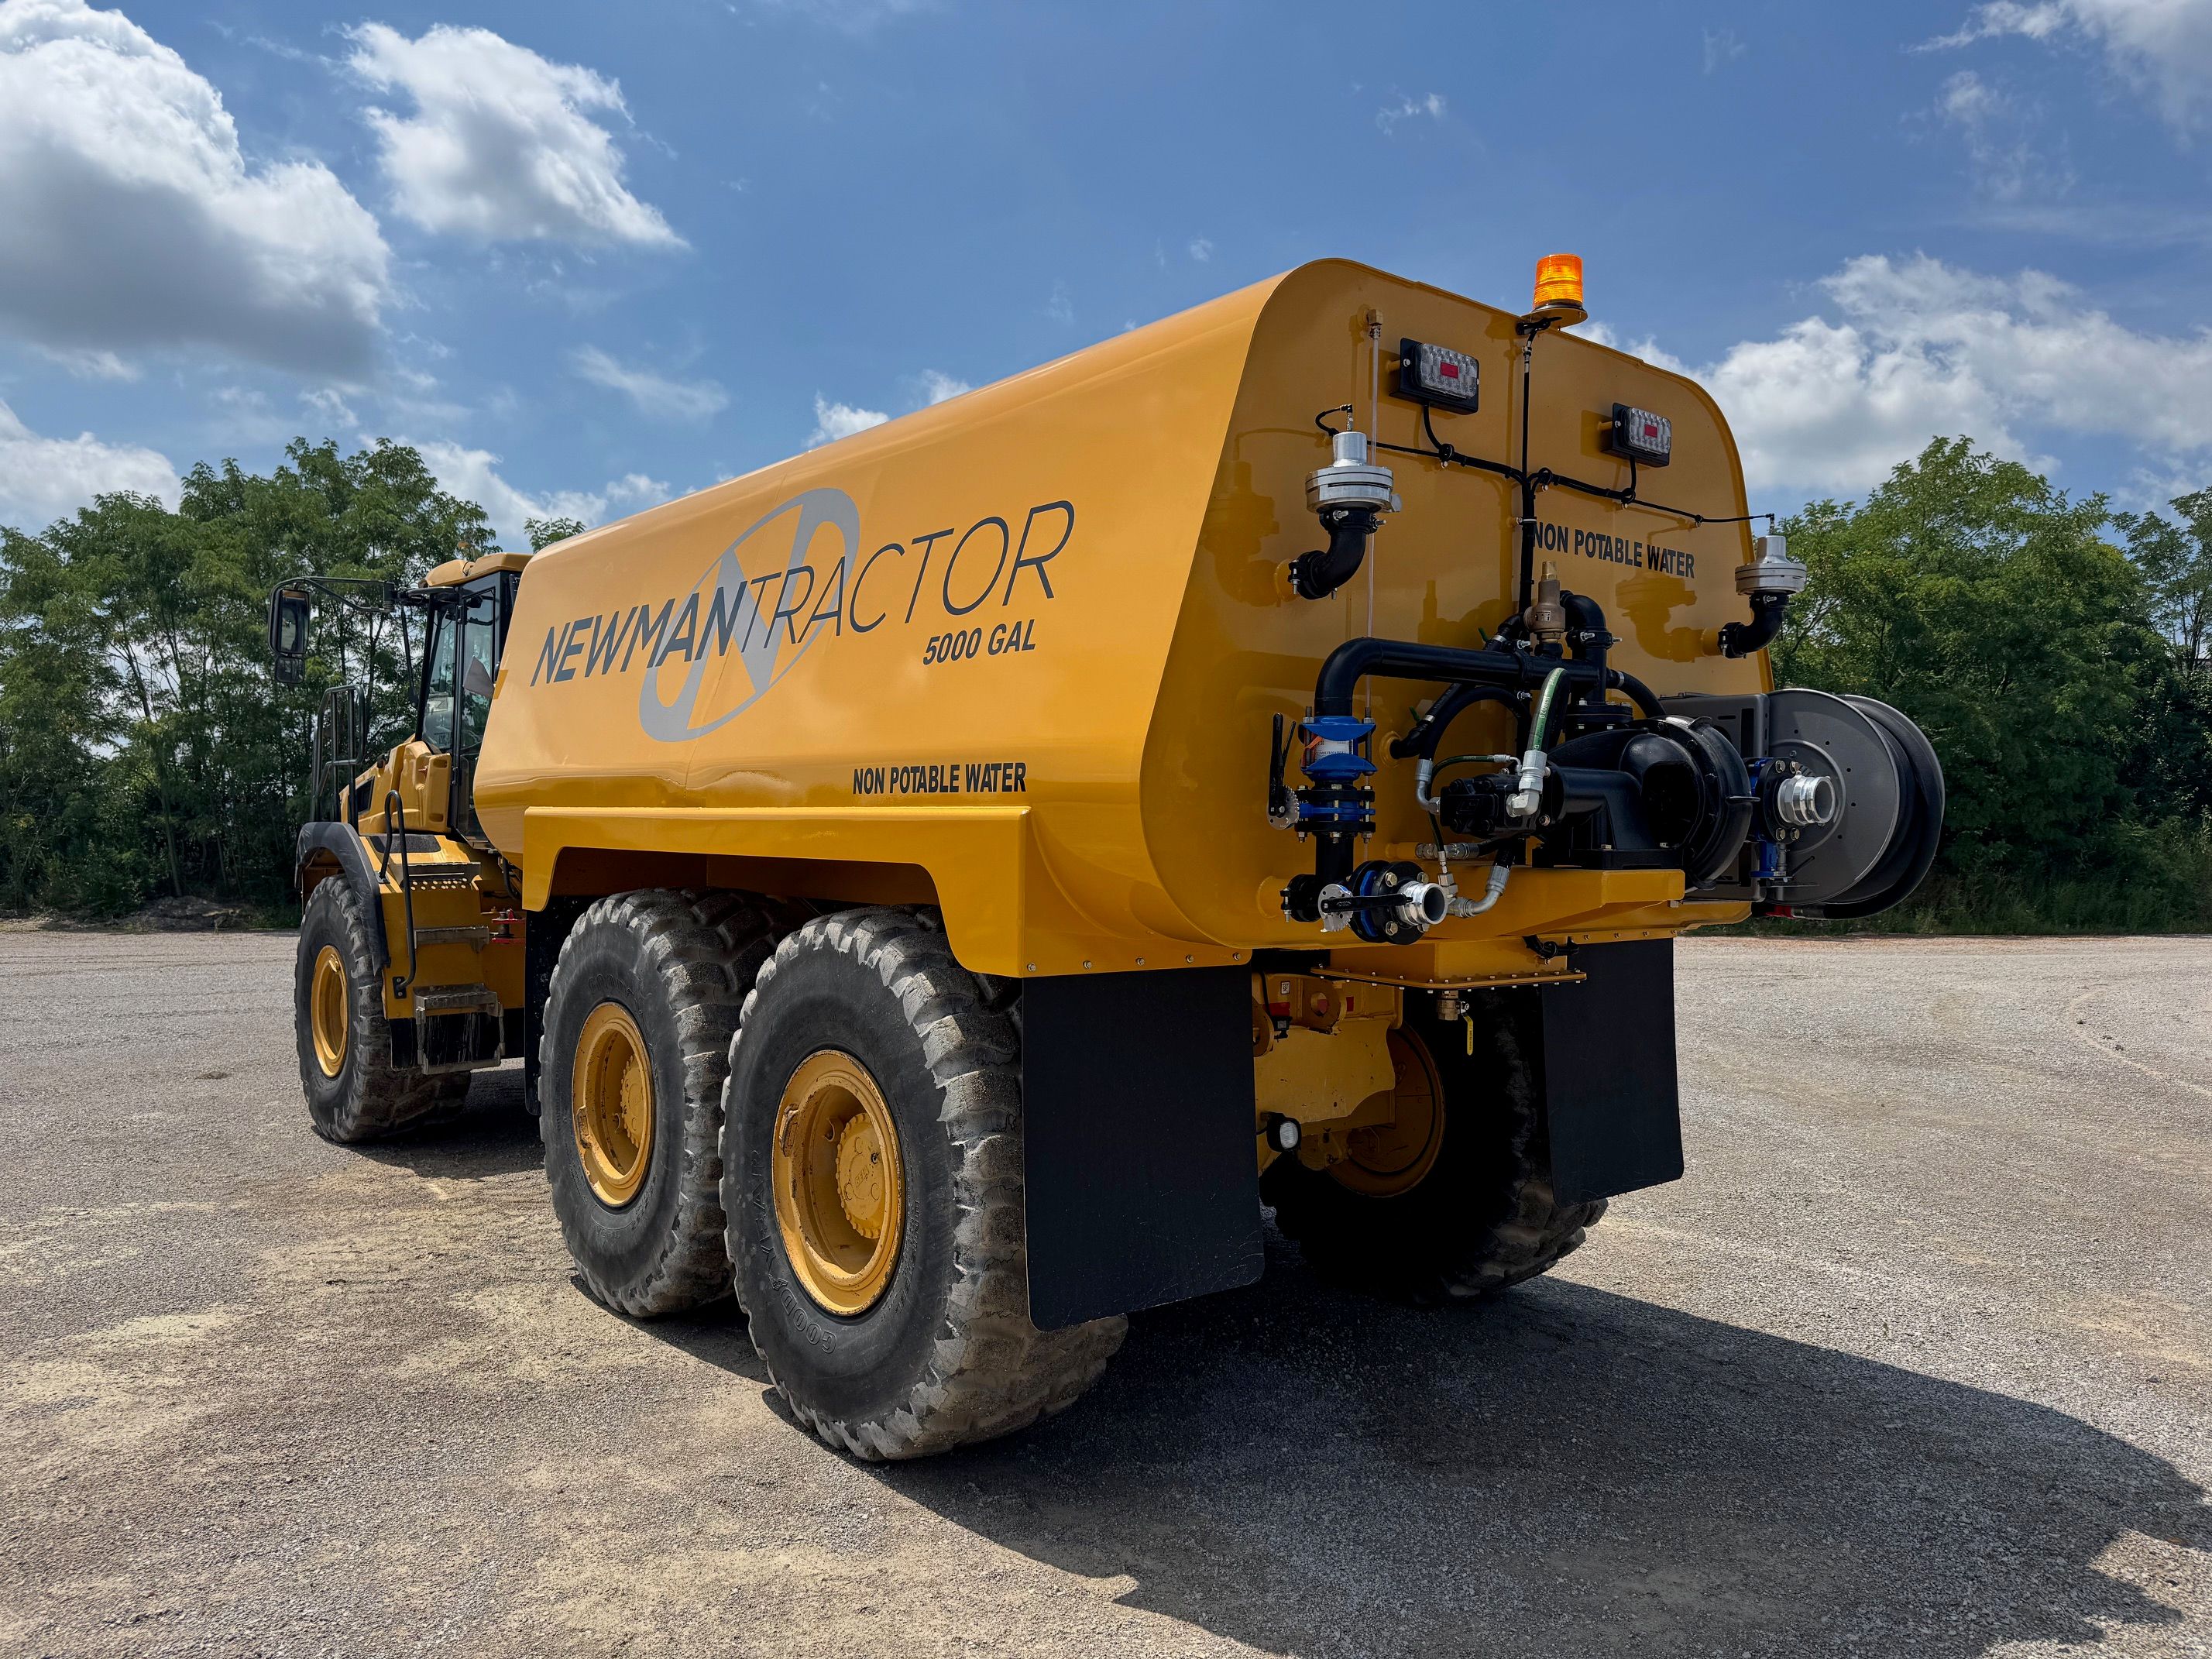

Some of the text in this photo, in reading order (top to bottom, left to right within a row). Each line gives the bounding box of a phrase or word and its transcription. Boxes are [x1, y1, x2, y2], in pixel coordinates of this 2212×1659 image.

[1534, 521, 1695, 579] NON POTABLE WATER
[922, 619, 1036, 665] 5000 GAL
[853, 762, 1027, 795] NON POTABLE WATER
